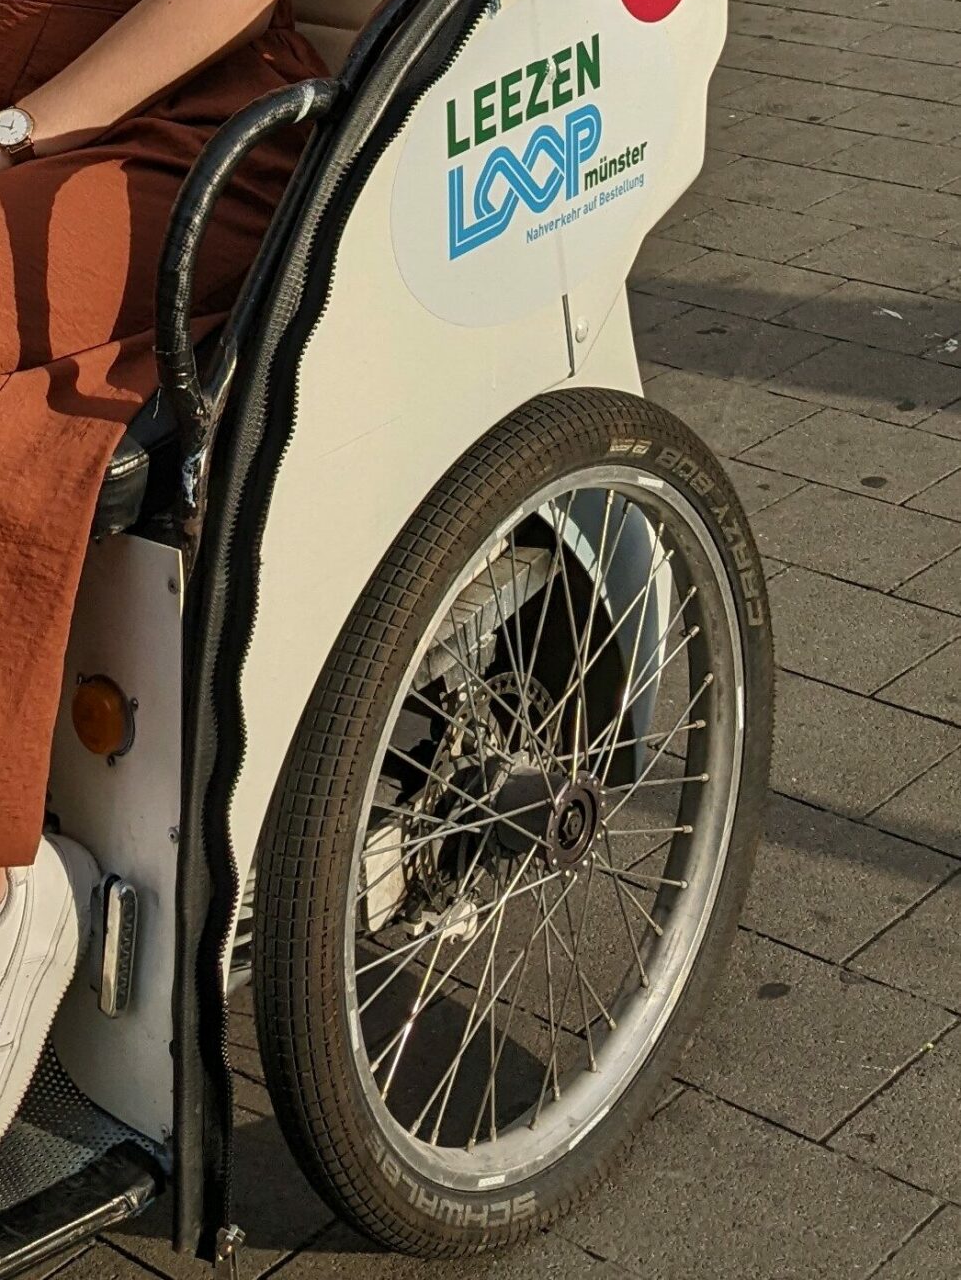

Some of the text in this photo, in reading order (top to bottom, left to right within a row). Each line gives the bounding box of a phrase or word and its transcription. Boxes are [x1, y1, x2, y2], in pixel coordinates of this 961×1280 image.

[446, 33, 601, 159] LEEZEN
[448, 104, 647, 261] LOOP münster
[526, 172, 645, 243] Nahverkehr auf Bestellung
[365, 1130, 537, 1227] SCHWALBE
